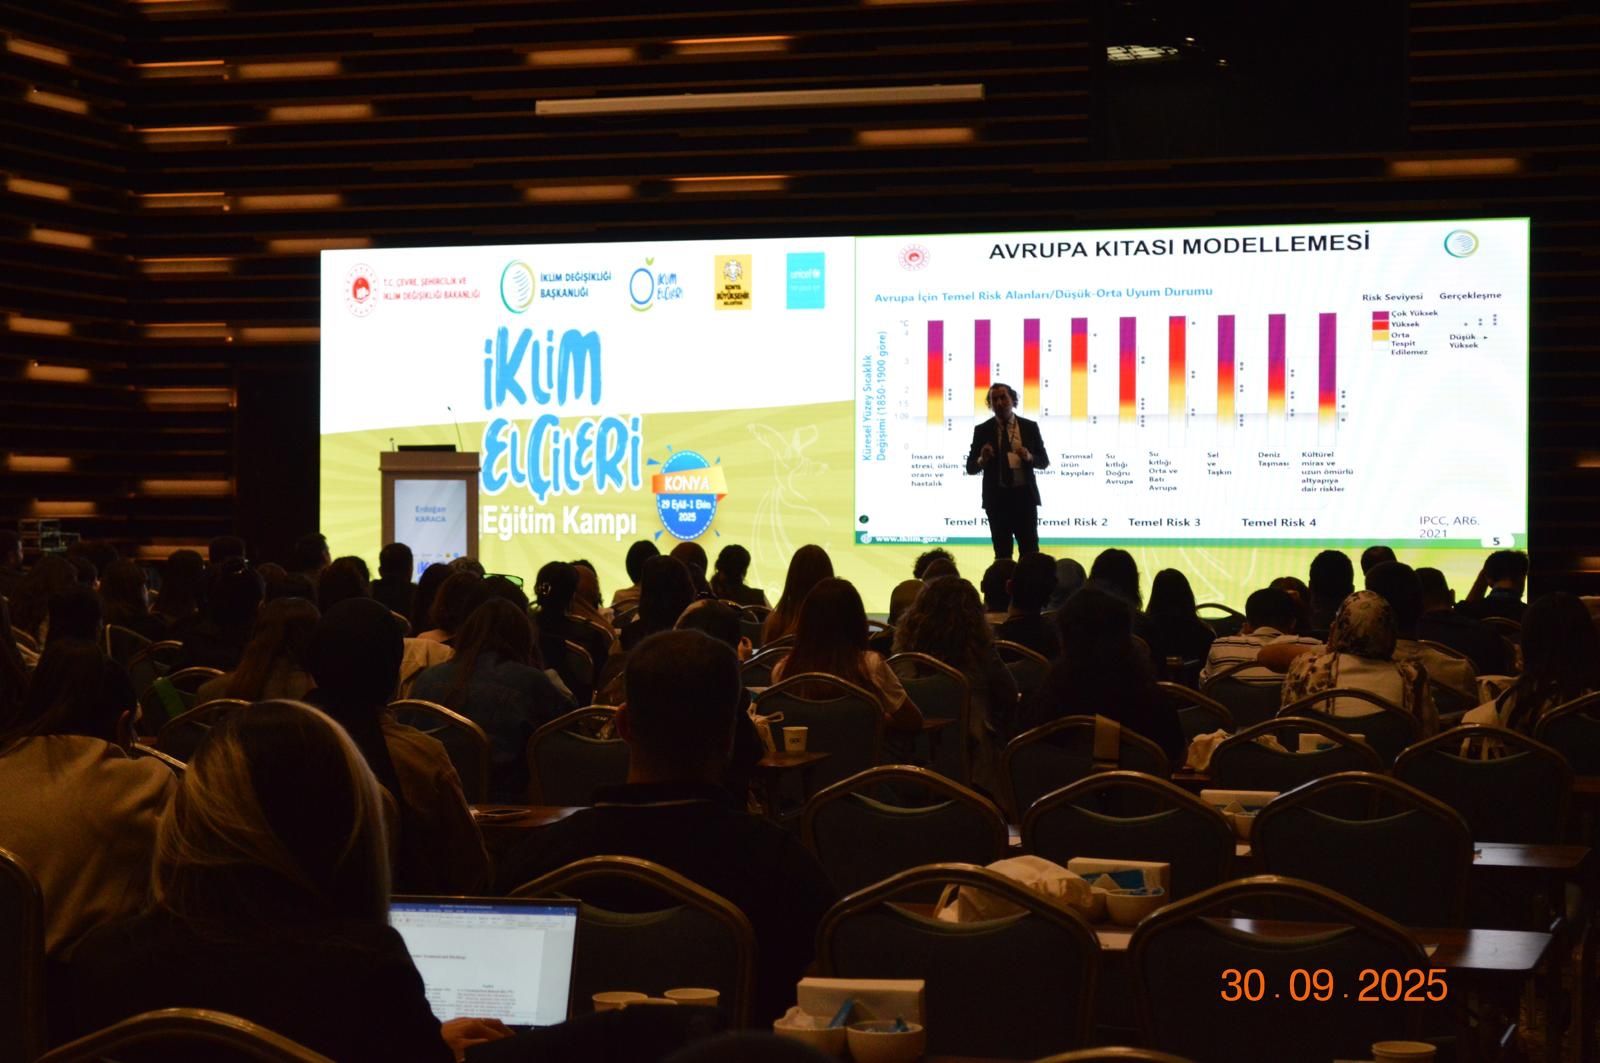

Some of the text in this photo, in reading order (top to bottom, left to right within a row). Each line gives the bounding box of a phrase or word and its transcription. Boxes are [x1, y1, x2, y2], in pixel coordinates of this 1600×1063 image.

[989, 230, 1370, 259] AVRUPA KITASI MODELLEMESİ
[540, 271, 612, 284] İKLİM DEĞİŞİKLİĞİ
[540, 287, 589, 300] BAŞKANLIĞI
[875, 293, 915, 304] Avrupa
[918, 288, 938, 303] İçin
[942, 292, 975, 301] Temel
[979, 290, 1002, 301] Risk
[1126, 287, 1161, 299] Uyum
[1164, 286, 1213, 297] Durumu
[1362, 292, 1424, 303] Risk Seviyesi
[1439, 290, 1502, 302] Gerçekleşme
[1410, 309, 1439, 317] Yüksek
[664, 476, 710, 492] KONYA
[678, 511, 697, 522] 2025
[944, 517, 978, 526] Temel
[1037, 517, 1108, 527] Temel Risk 2
[483, 505, 555, 541] Eğitim
[563, 506, 637, 541] Kampı
[1128, 518, 1201, 527] Temel Risk 3
[1242, 518, 1317, 527] Temel Risk 4
[1419, 529, 1448, 538] 2021
[1492, 537, 1500, 546] 5
